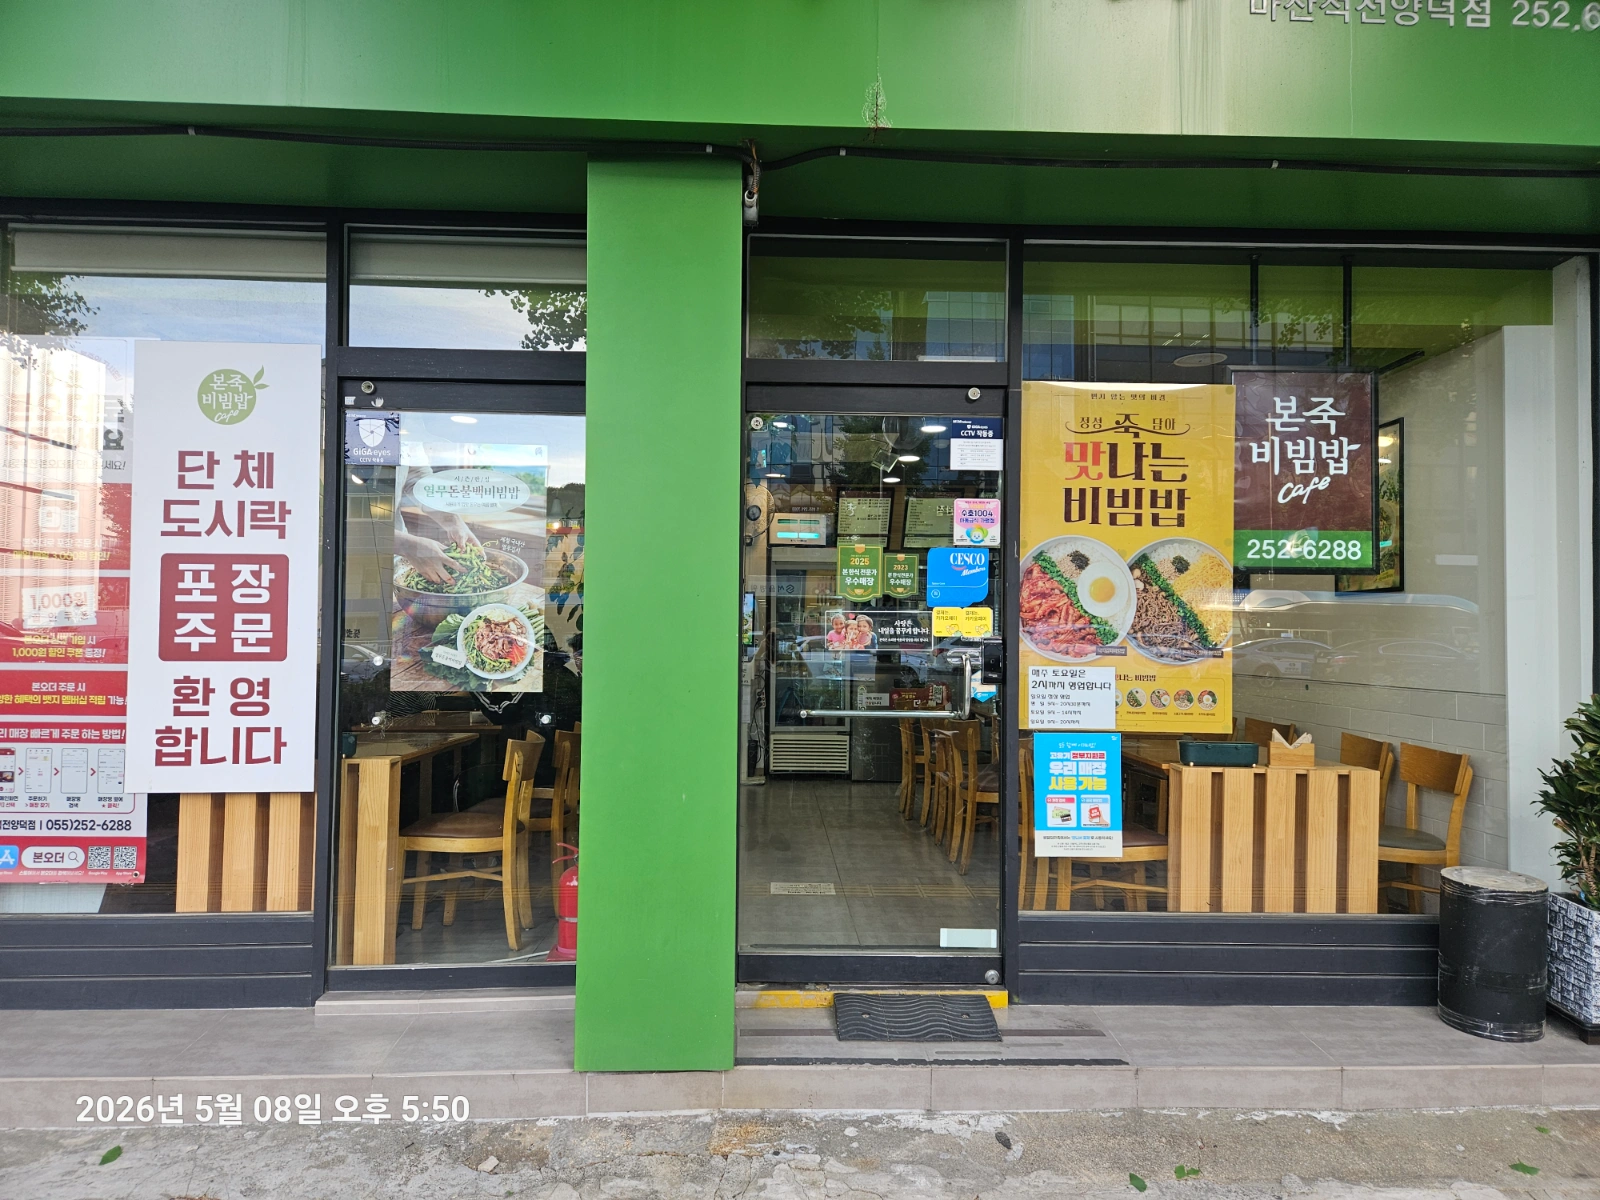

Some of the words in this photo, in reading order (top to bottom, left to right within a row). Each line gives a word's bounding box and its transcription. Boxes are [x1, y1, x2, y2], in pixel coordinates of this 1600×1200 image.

[209, 373, 247, 392] 본죽
[201, 391, 254, 410] 비빔밥
[1265, 395, 1346, 436] 본죽
[1080, 417, 1103, 430] 정성
[1114, 413, 1140, 439] 죽
[1152, 418, 1176, 431] 담아
[1063, 441, 1189, 483] 맛나는
[1249, 436, 1362, 476] 비빔밥
[961, 509, 994, 517] 수호1004
[1062, 486, 1191, 528] 비빔밥
[160, 499, 292, 540] 도시락
[1246, 538, 1362, 560] 252-6288
[849, 557, 870, 566] 2025
[949, 552, 986, 566] CESCO
[841, 568, 849, 576] 본
[849, 568, 860, 576] 한식
[844, 577, 875, 586] 우수매장
[87, 635, 96, 645] 시
[12, 647, 47, 657] 1,000원
[1031, 669, 1048, 678] 매주
[1052, 669, 1086, 678] 토요일은
[31, 682, 57, 692] 본오더
[58, 682, 75, 692] 주문
[76, 682, 86, 692] 시
[1031, 680, 1065, 690] 2시까지
[1068, 681, 1111, 691] 영업합니다
[8, 728, 29, 739] 매장
[30, 728, 60, 739] 빠르게
[61, 729, 80, 739] 주문
[81, 729, 100, 740] 하는
[101, 729, 126, 740] 방법!
[154, 725, 288, 767] 합니다
[1049, 761, 1077, 775] 우리
[1078, 761, 1107, 776] 매장
[1048, 776, 1077, 791] 사용
[1078, 776, 1107, 791] 가능
[0, 819, 36, 831] 전양덕점
[46, 818, 132, 832] 055)252-6288
[33, 851, 65, 864] 본오더
